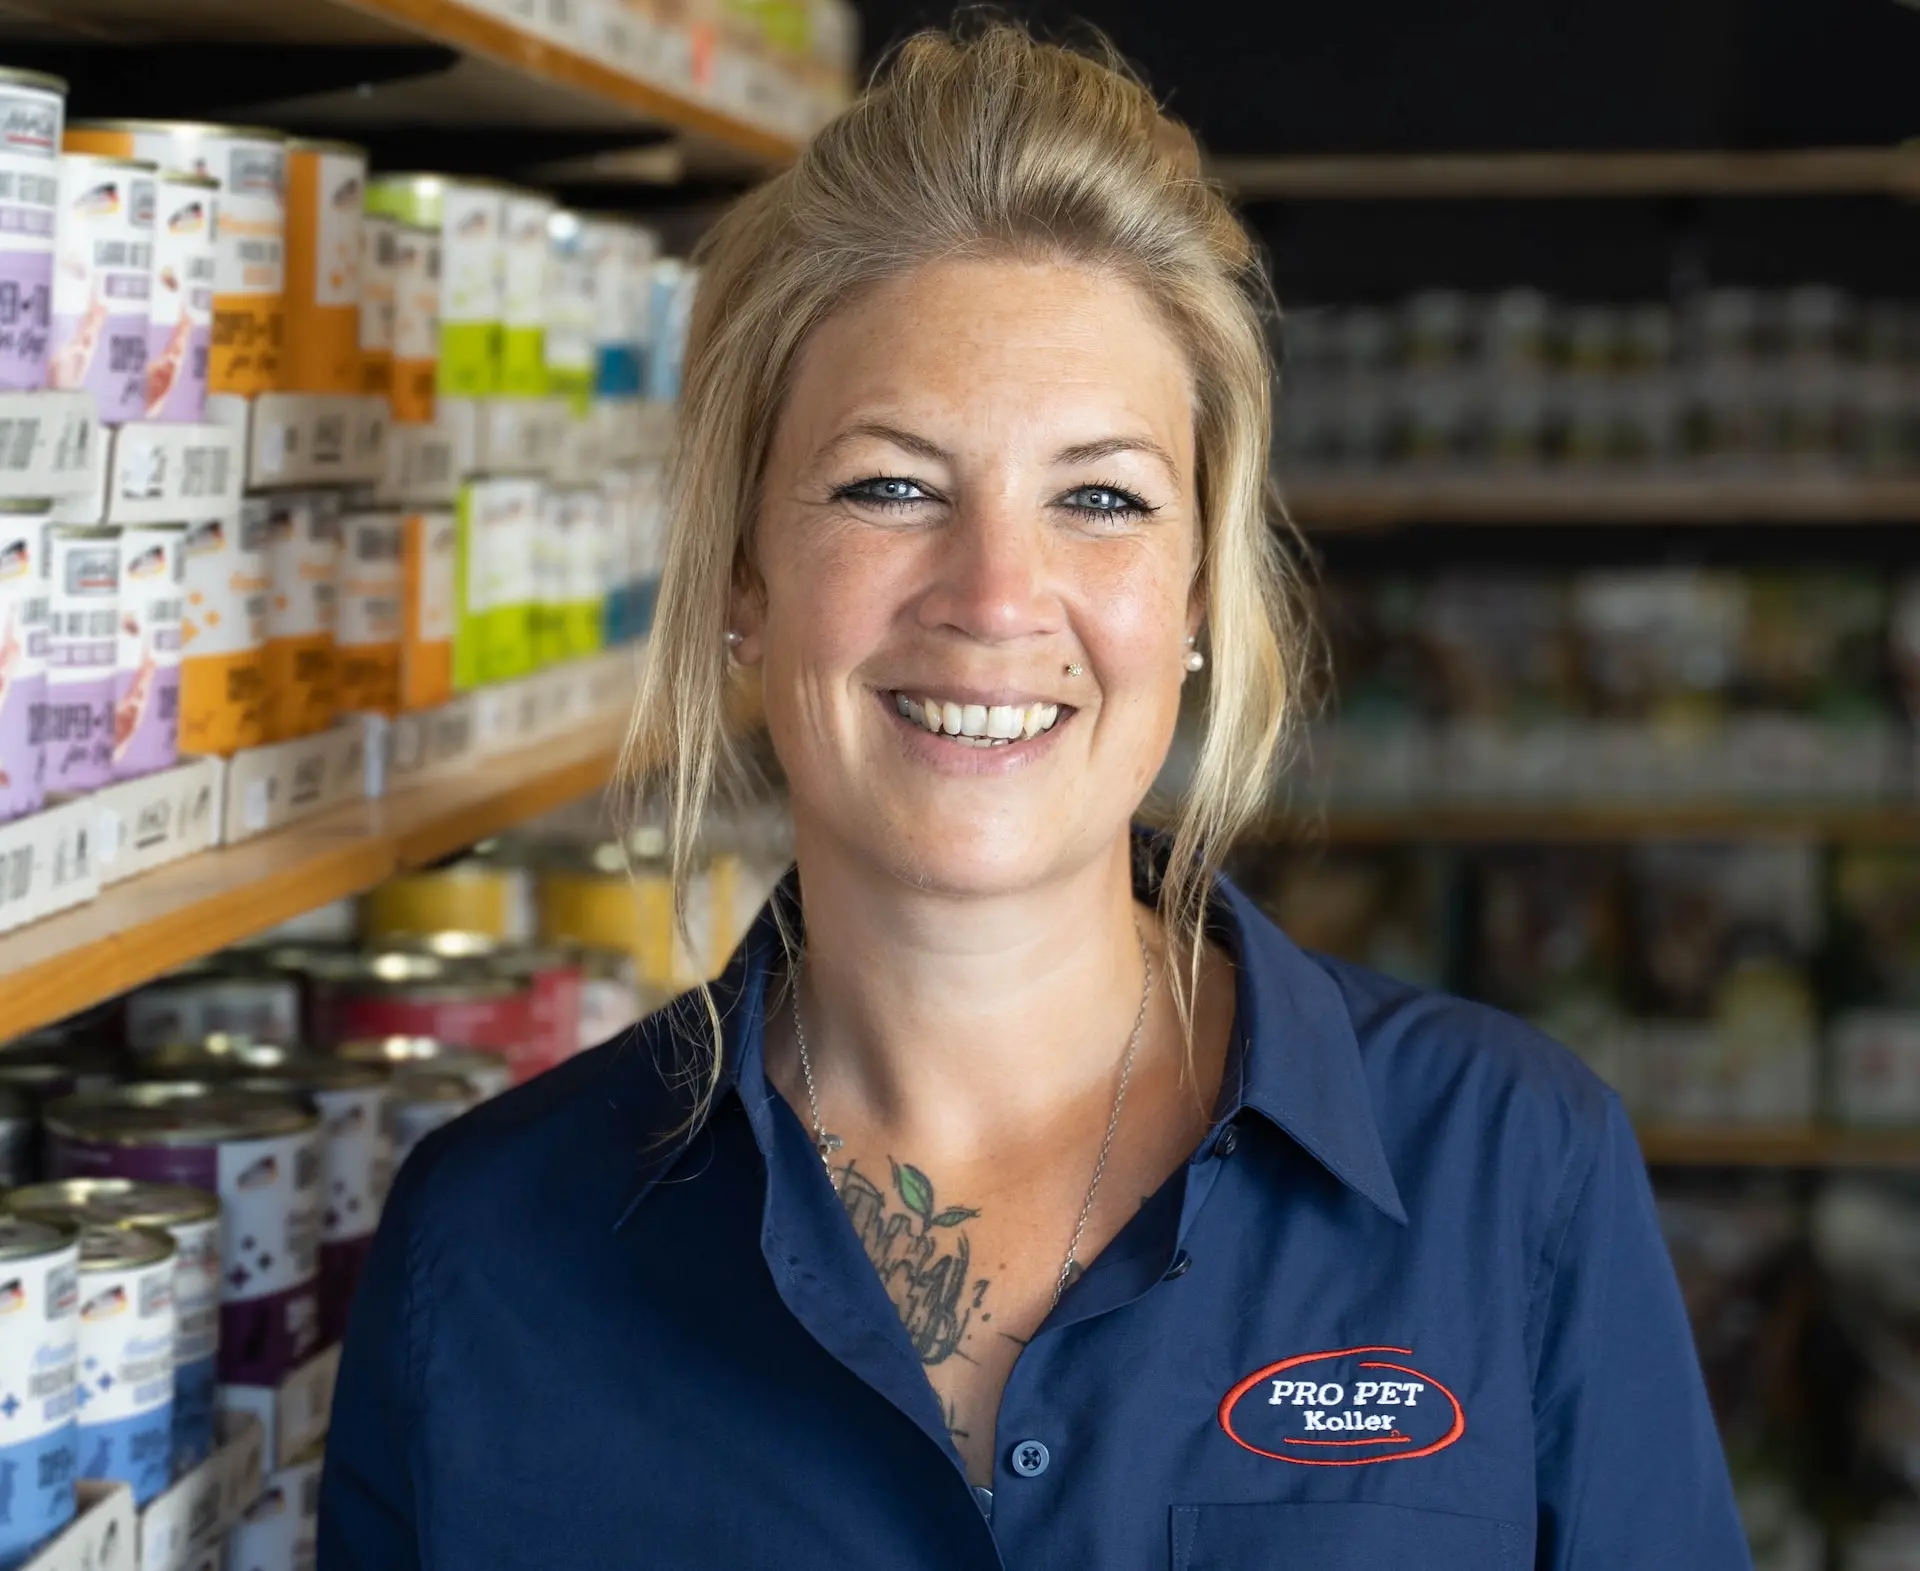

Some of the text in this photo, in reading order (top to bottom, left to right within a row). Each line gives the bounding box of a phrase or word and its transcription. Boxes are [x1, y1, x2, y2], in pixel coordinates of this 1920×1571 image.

[1268, 1380, 1424, 1406] PRO PET
[1303, 1410, 1396, 1431] Koller
